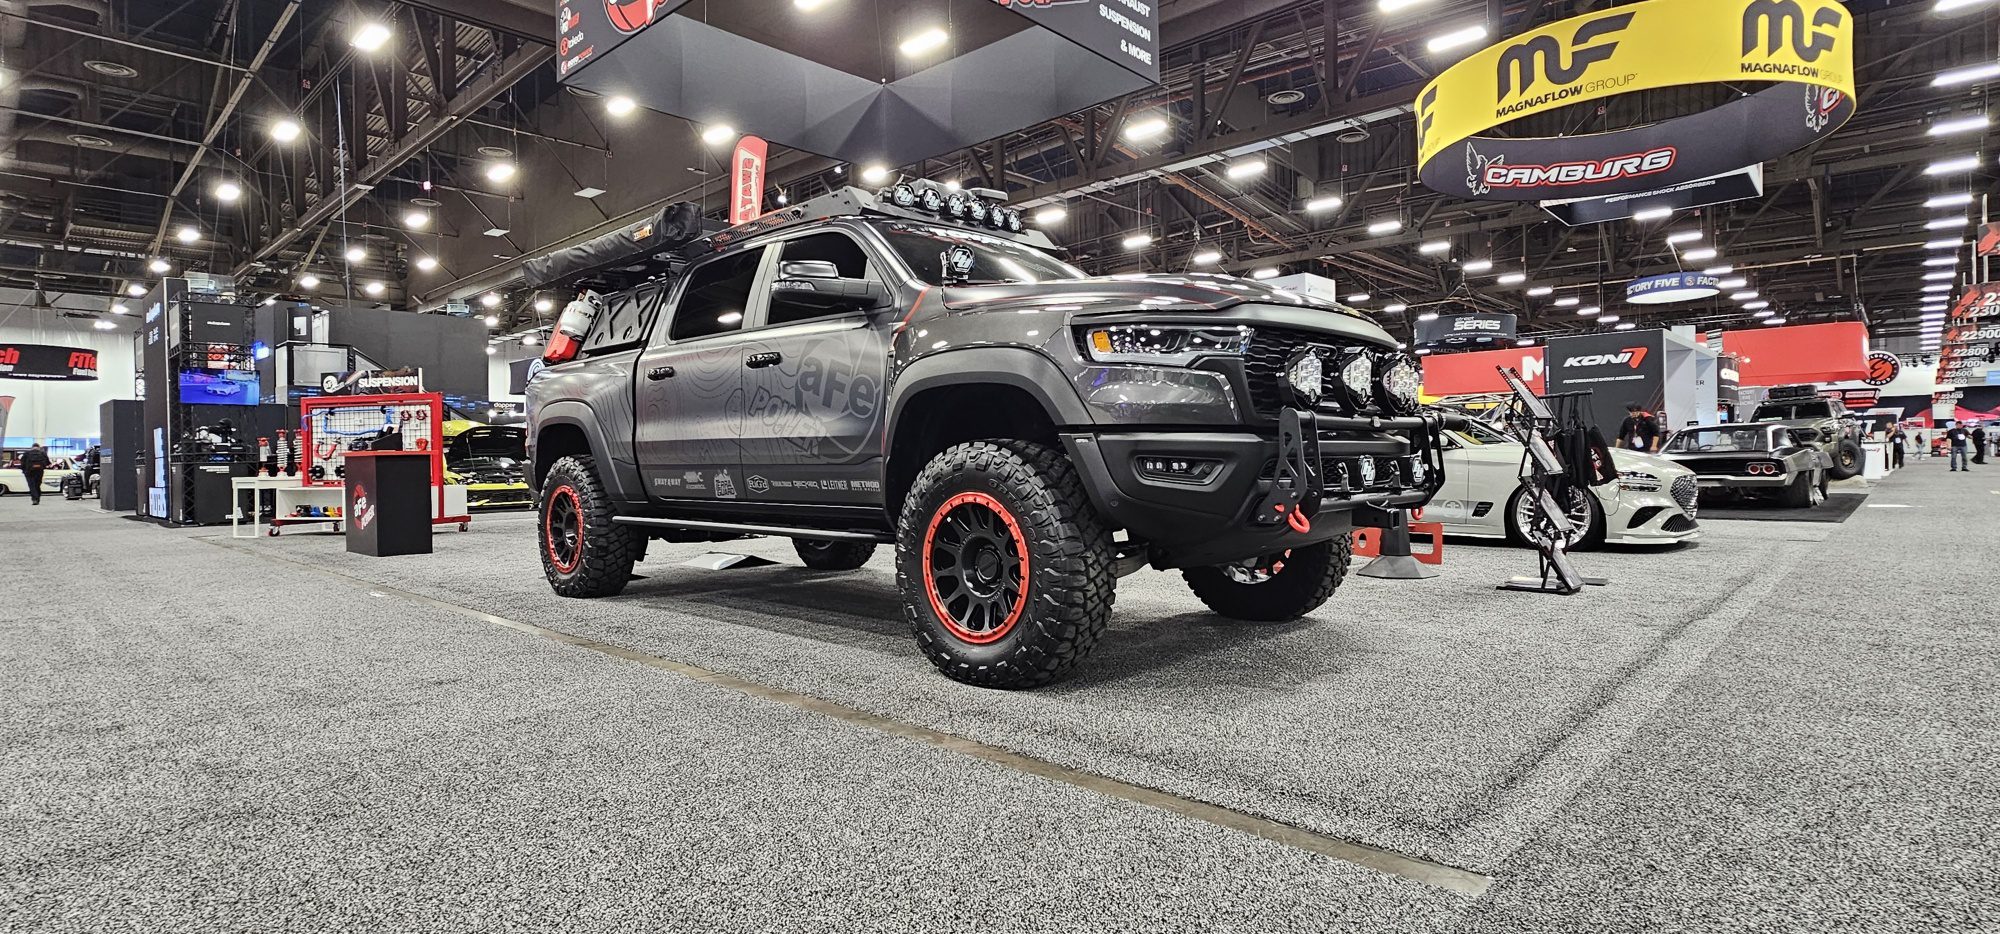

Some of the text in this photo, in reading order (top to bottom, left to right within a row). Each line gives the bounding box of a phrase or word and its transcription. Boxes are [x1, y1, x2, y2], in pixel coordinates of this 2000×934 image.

[1099, 4, 1151, 41] SUSPENSION
[1120, 39, 1152, 65] & MORE
[1740, 63, 1819, 78] MAGNAFLOW
[1495, 73, 1638, 119] MAGNAFLOW GROUP
[1486, 149, 1673, 186] CAMBURG
[1605, 180, 1716, 204] PERFORMANCE SHOCK ABSORBERS
[1654, 277, 1680, 289] FIVE
[1453, 320, 1501, 331] SERIES
[1563, 351, 1634, 368] KONI
[1953, 347, 1989, 357] 22800
[1949, 360, 1980, 369] 22700
[358, 376, 418, 388] SUSPENSION
[801, 355, 875, 417] aFe
[850, 480, 880, 488] METHOD
